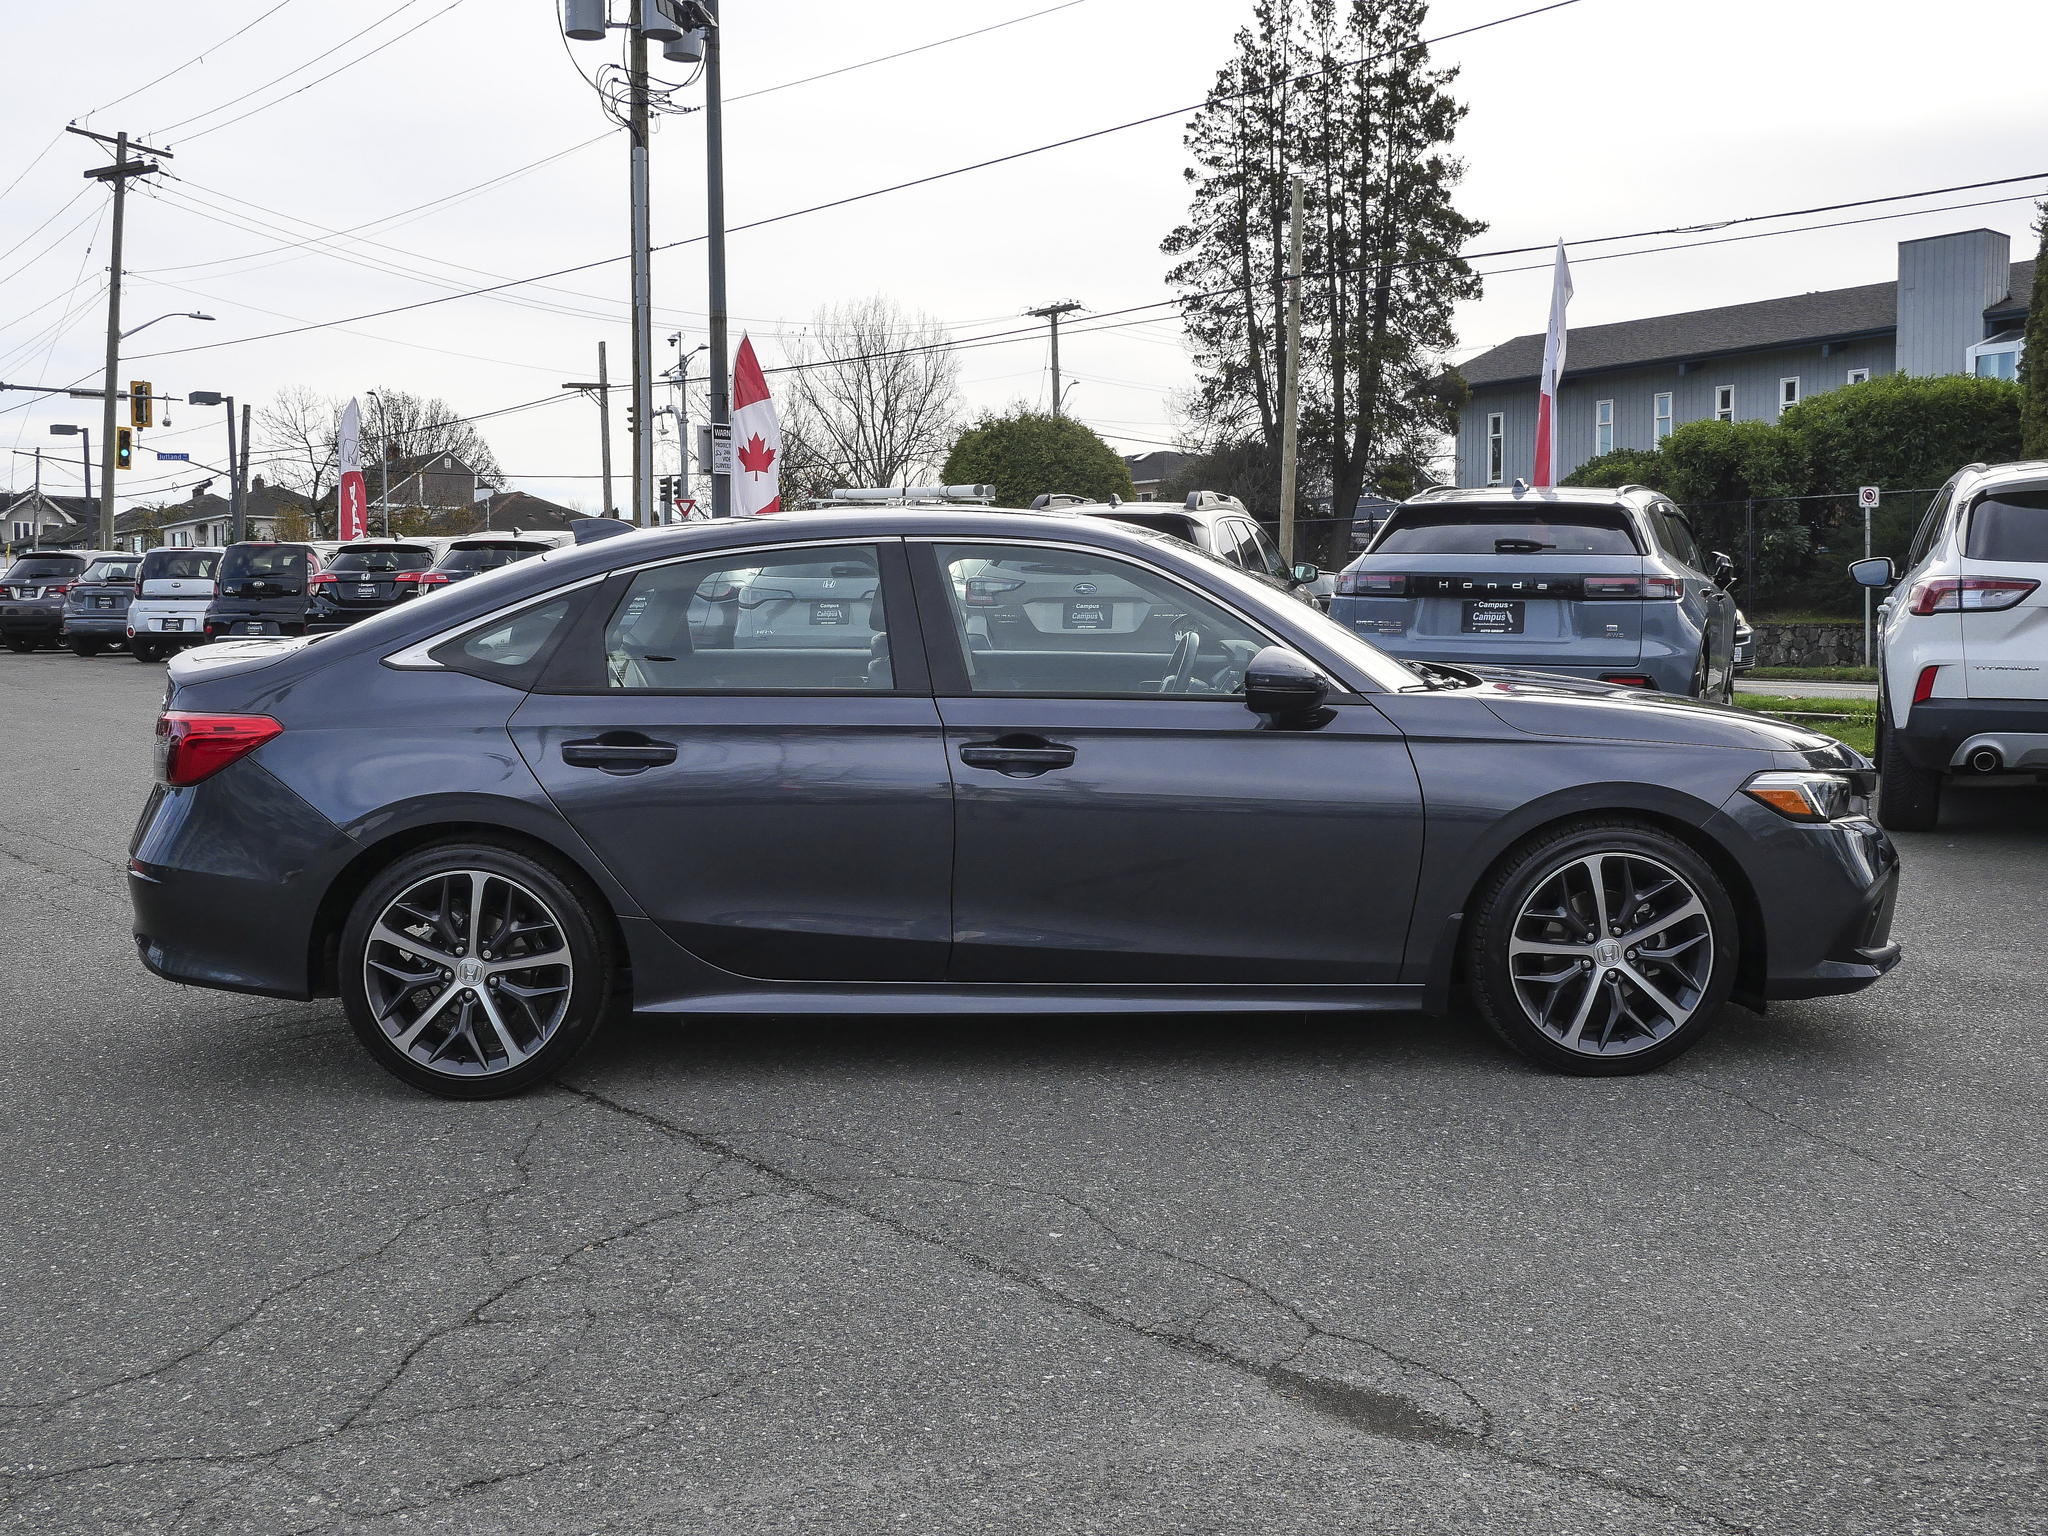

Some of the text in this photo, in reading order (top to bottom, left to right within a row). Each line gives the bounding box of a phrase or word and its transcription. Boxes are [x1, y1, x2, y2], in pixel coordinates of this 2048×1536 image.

[1438, 581, 1548, 589] Honda
[1478, 601, 1509, 609] Campus
[817, 610, 838, 618] Campus
[1072, 612, 1098, 620] Campus
[1472, 612, 1506, 622] Campus
